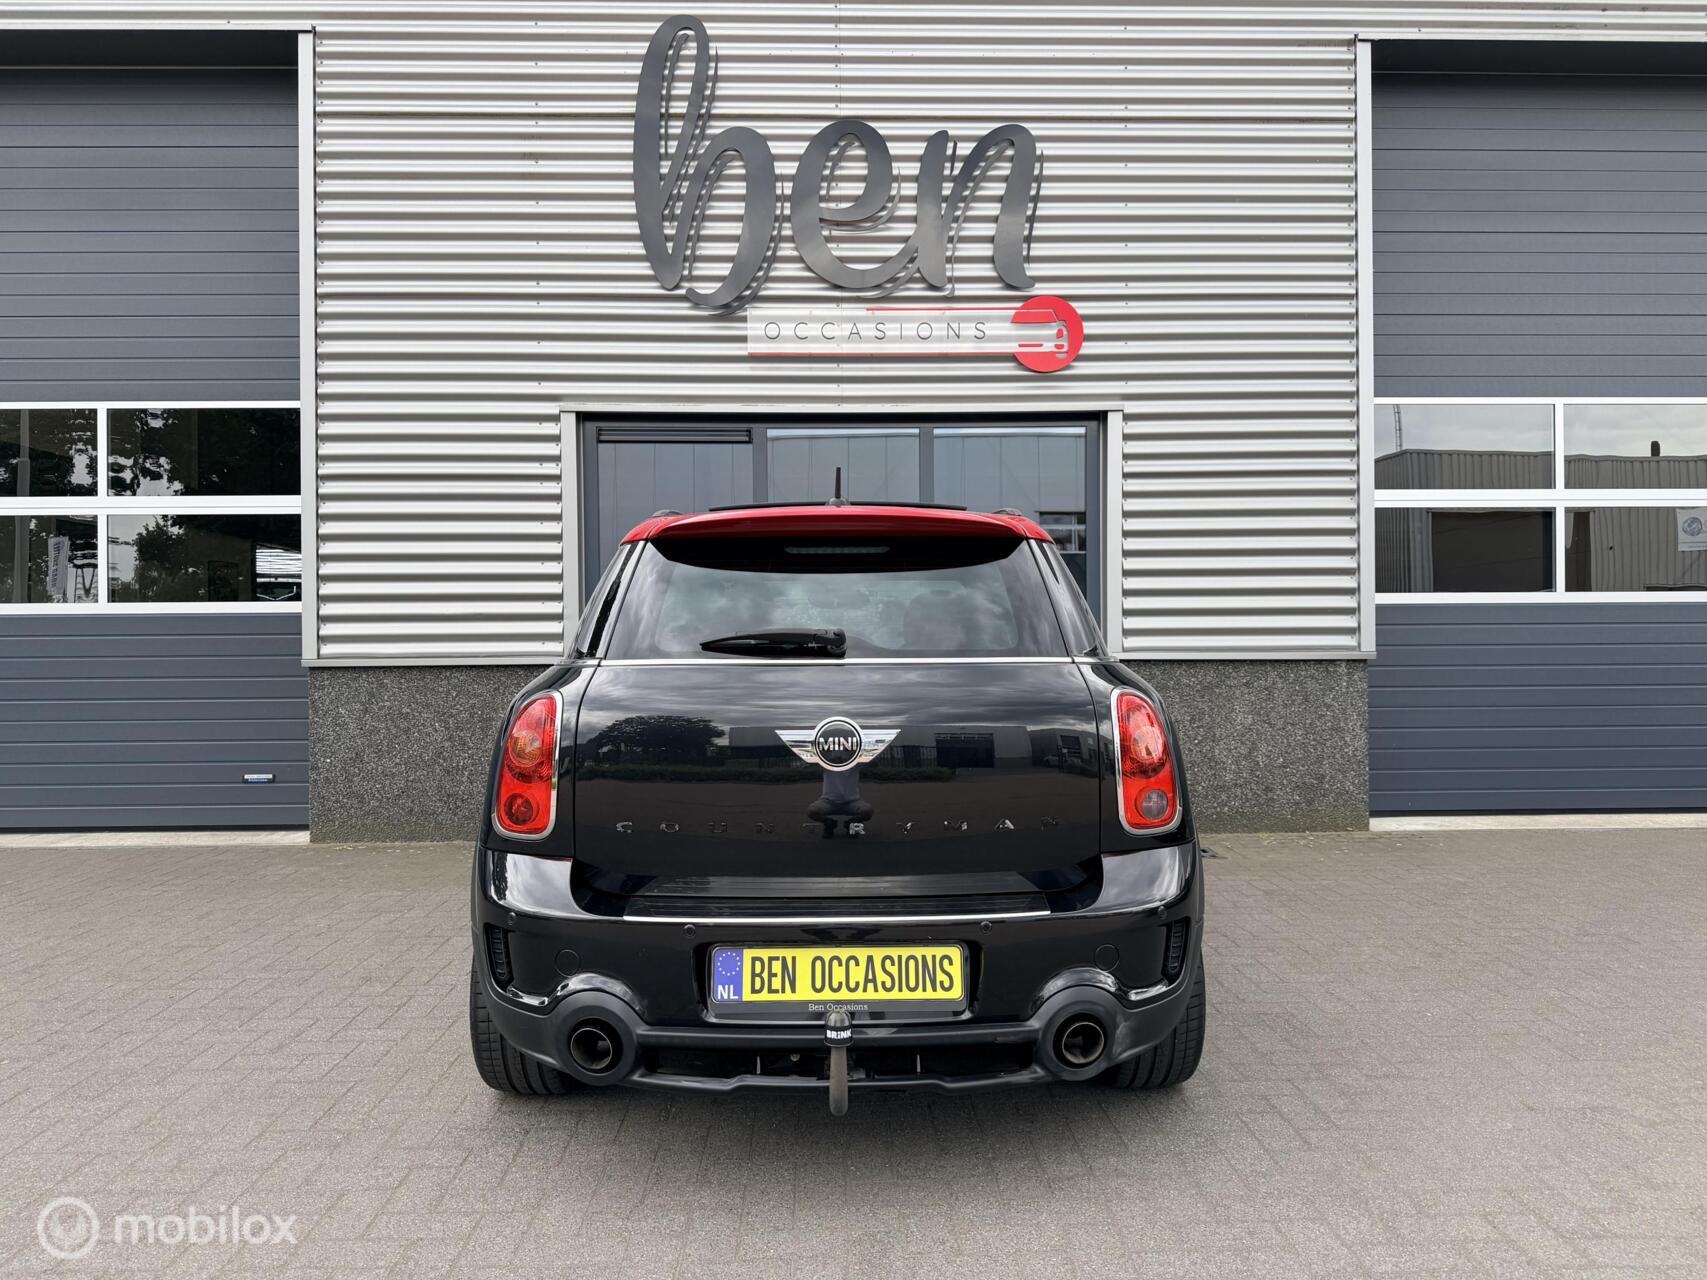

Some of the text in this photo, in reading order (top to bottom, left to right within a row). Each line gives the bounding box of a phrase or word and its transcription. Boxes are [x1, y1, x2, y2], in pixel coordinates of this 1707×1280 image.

[633, 14, 1038, 308] ben
[764, 321, 988, 341] OCCASIONS
[819, 736, 857, 751] MINI
[751, 954, 954, 995] BEN OCCASIONS
[718, 985, 739, 1000] NL
[808, 1003, 868, 1011] Ben Occasions
